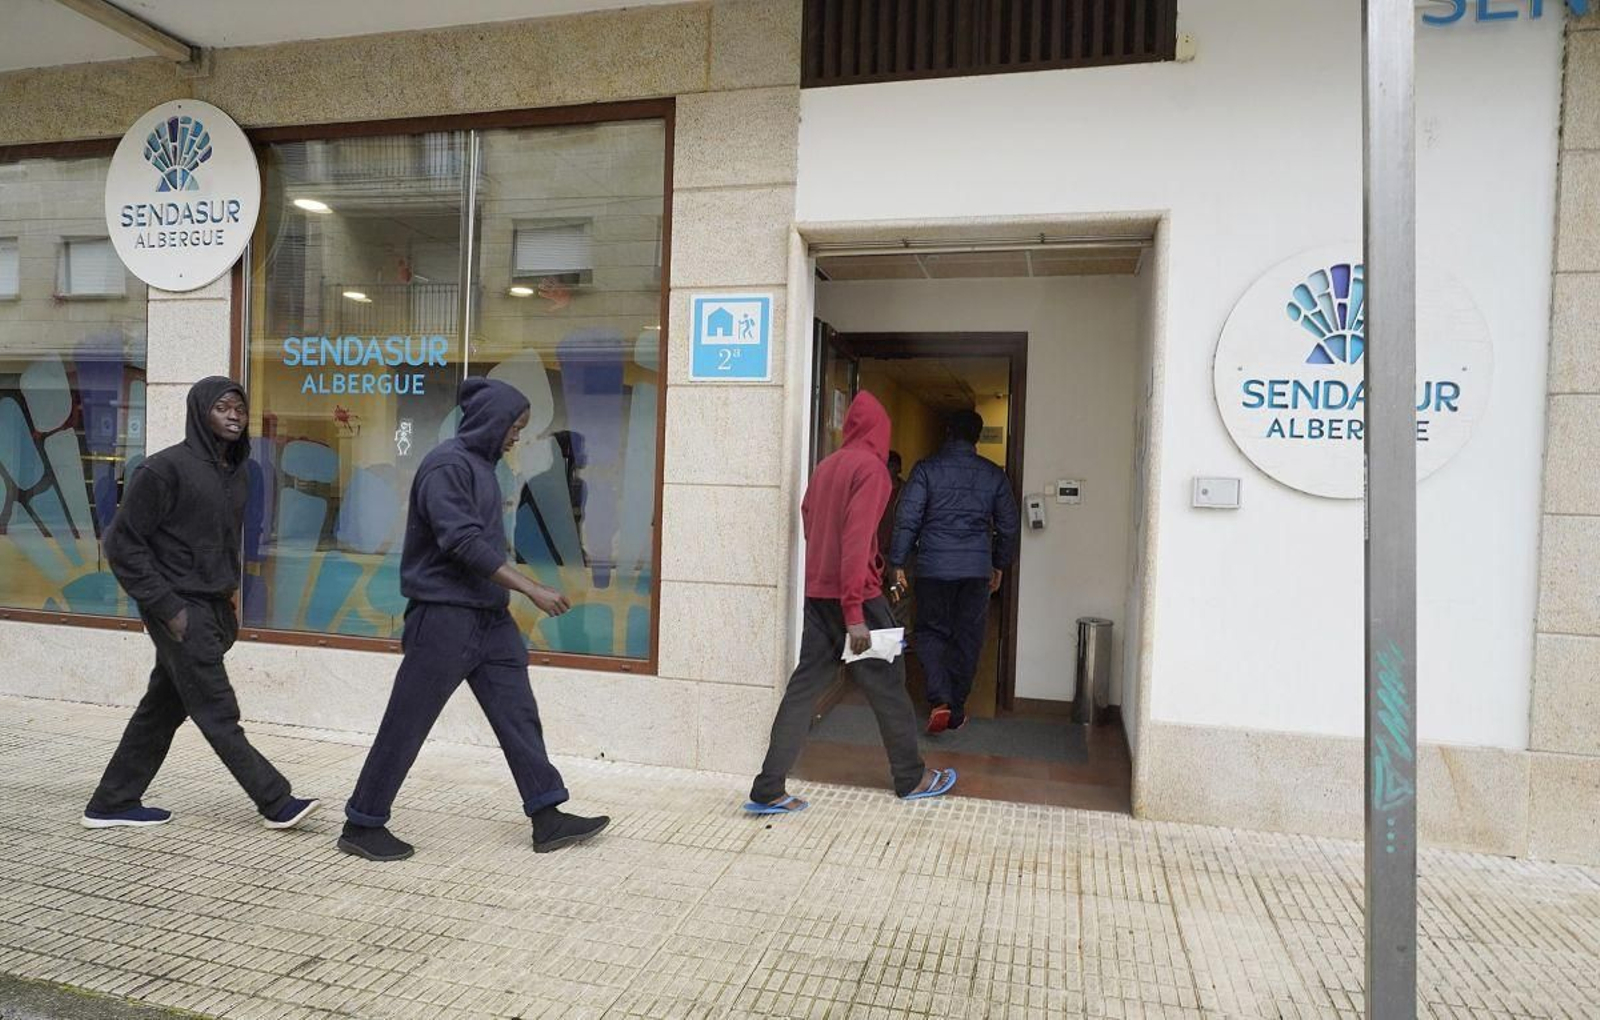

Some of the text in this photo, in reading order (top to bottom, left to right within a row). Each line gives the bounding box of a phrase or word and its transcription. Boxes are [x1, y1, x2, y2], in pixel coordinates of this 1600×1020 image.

[121, 199, 241, 228] SENDASUR
[135, 229, 225, 249] ALBERGUE
[283, 335, 449, 367] SENDASUR
[301, 372, 426, 395] ALBERGUE
[1242, 379, 1460, 412] SENDAUR
[1266, 417, 1430, 442] ALBERE
